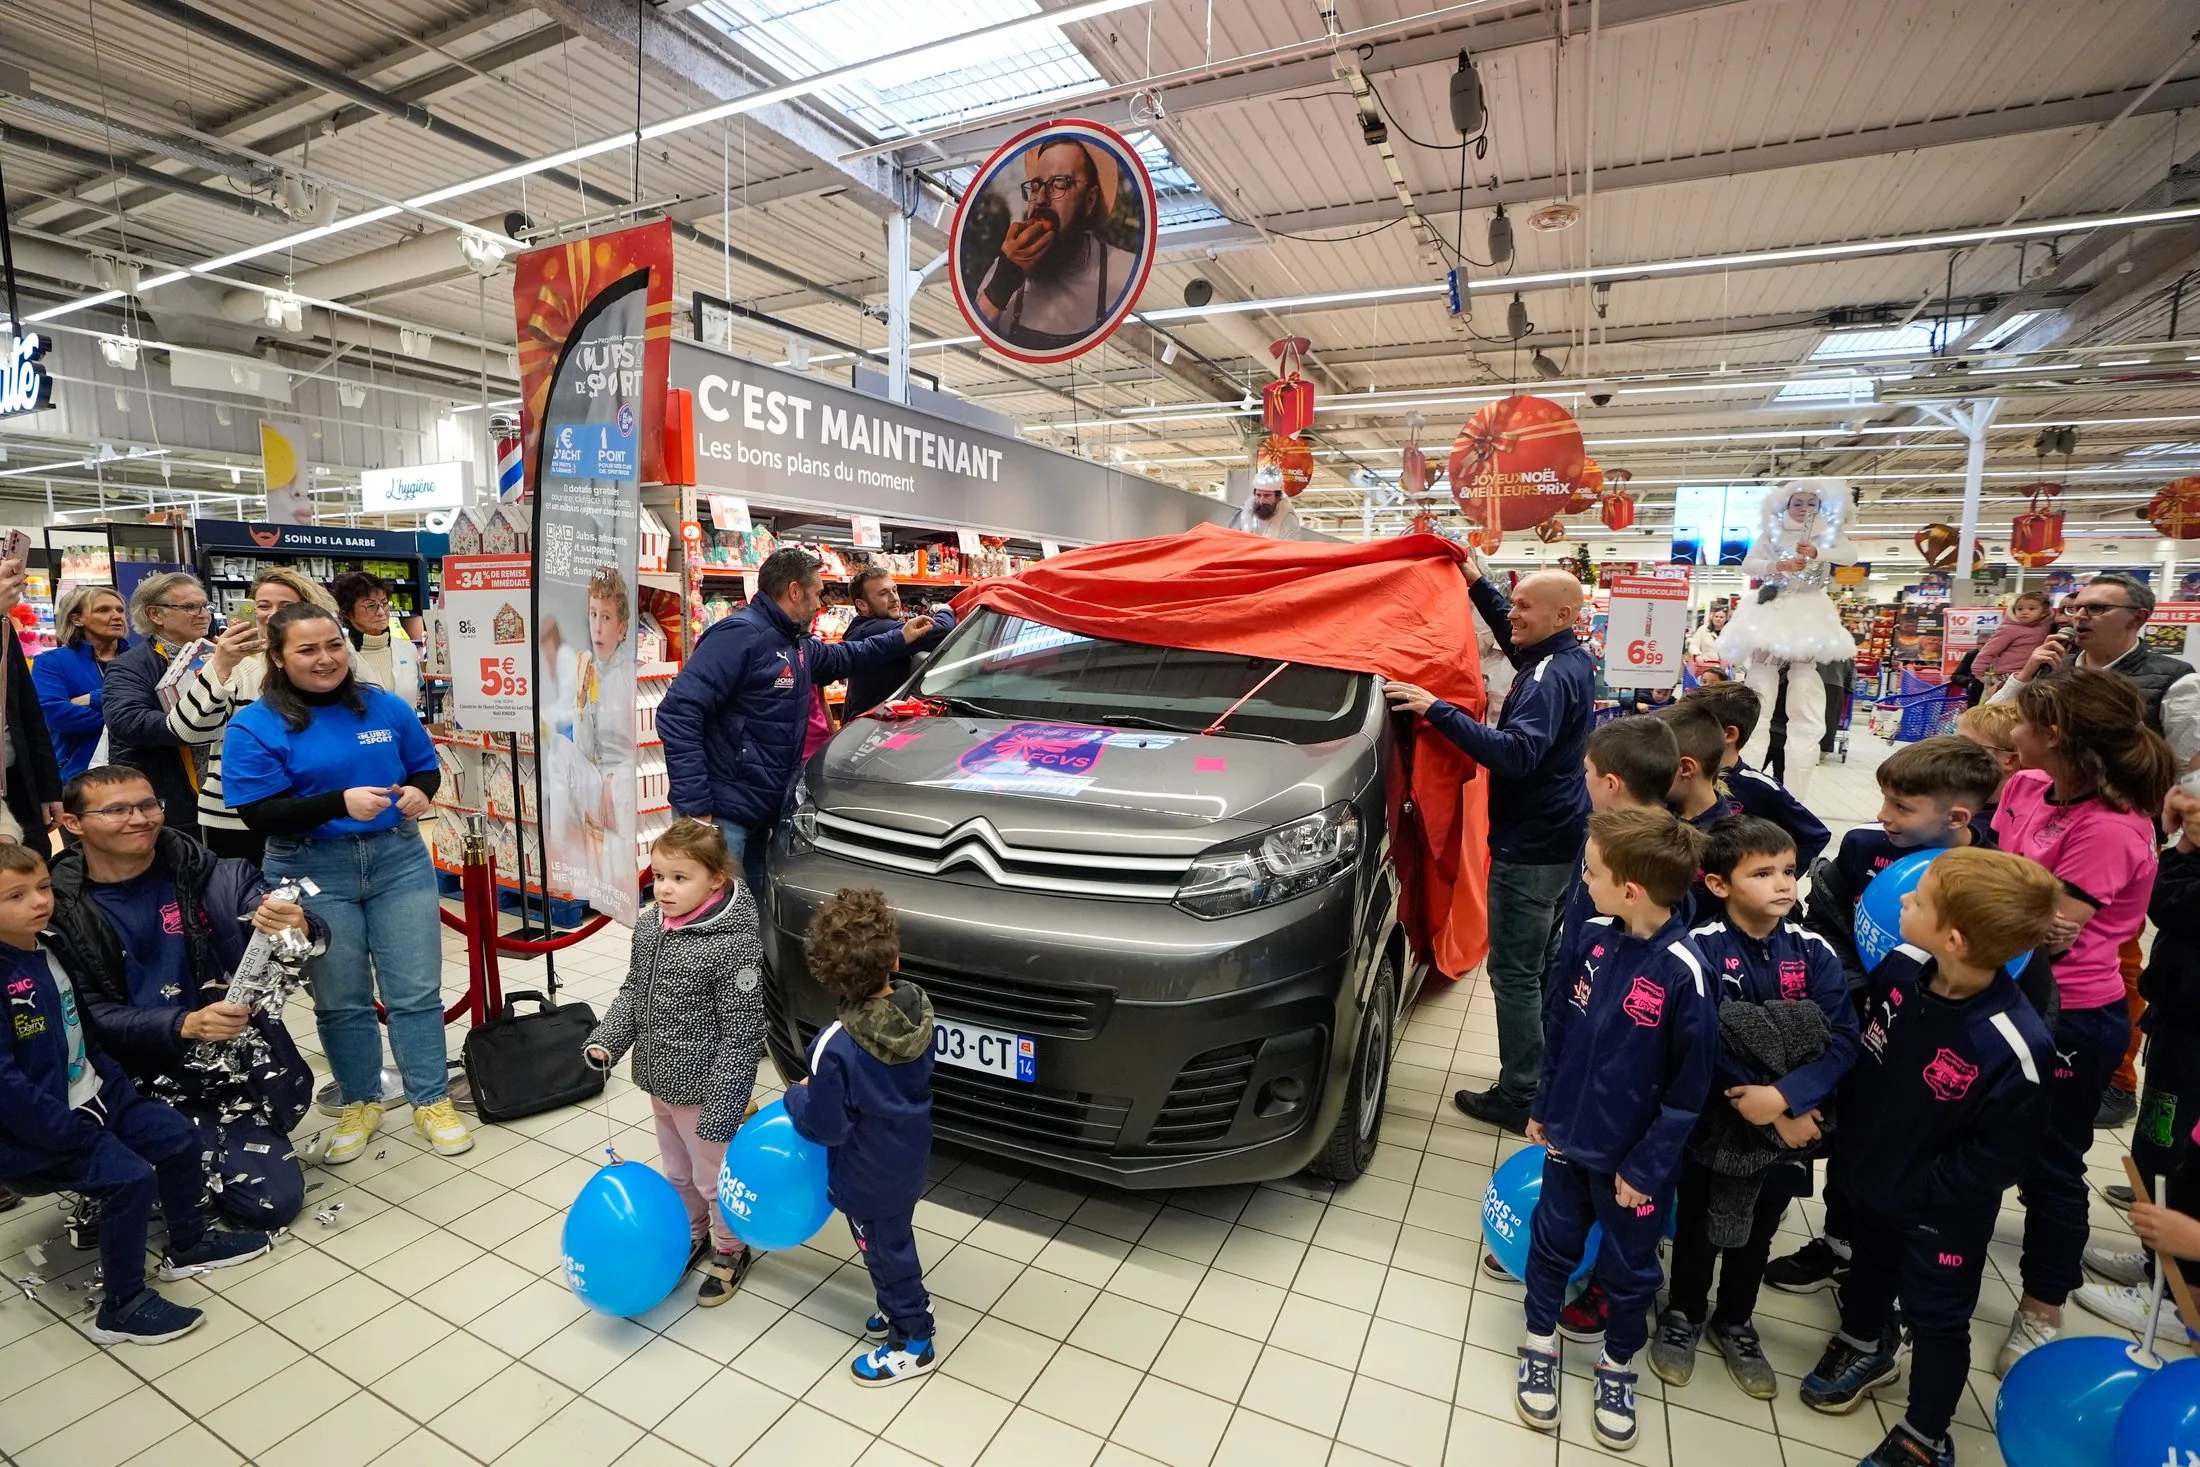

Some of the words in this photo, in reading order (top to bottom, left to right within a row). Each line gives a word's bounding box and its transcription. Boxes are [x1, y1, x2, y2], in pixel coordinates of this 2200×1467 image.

[698, 374, 811, 439] C'EST
[820, 405, 1003, 482] MAINTENANT
[600, 427, 608, 449] 1
[598, 450, 626, 462] POINT
[699, 433, 732, 461] Les
[737, 439, 782, 469] bons
[787, 451, 830, 479] plans
[834, 461, 853, 483] du
[858, 471, 915, 493] moment
[1521, 468, 1559, 483] NOËL
[386, 478, 436, 500] L'hygiène
[285, 534, 311, 544] SOIN
[314, 535, 327, 544] DE
[330, 537, 343, 545] LA
[345, 537, 376, 547] BARBE
[491, 578, 531, 587] IMMÉDIATE
[1977, 615, 1998, 625] 2+1
[2171, 612, 2186, 620] LE
[365, 735, 392, 745] SPORT
[1028, 753, 1091, 767] FCVS
[1855, 907, 1880, 943] UBS
[1725, 958, 1740, 969] NP
[8, 978, 33, 994] CMC
[1019, 1059, 1032, 1075] 14
[744, 1190, 757, 1201] DE
[1636, 1204, 1655, 1218] MP
[1509, 1213, 1522, 1227] DE
[1938, 1252, 1963, 1267] MD
